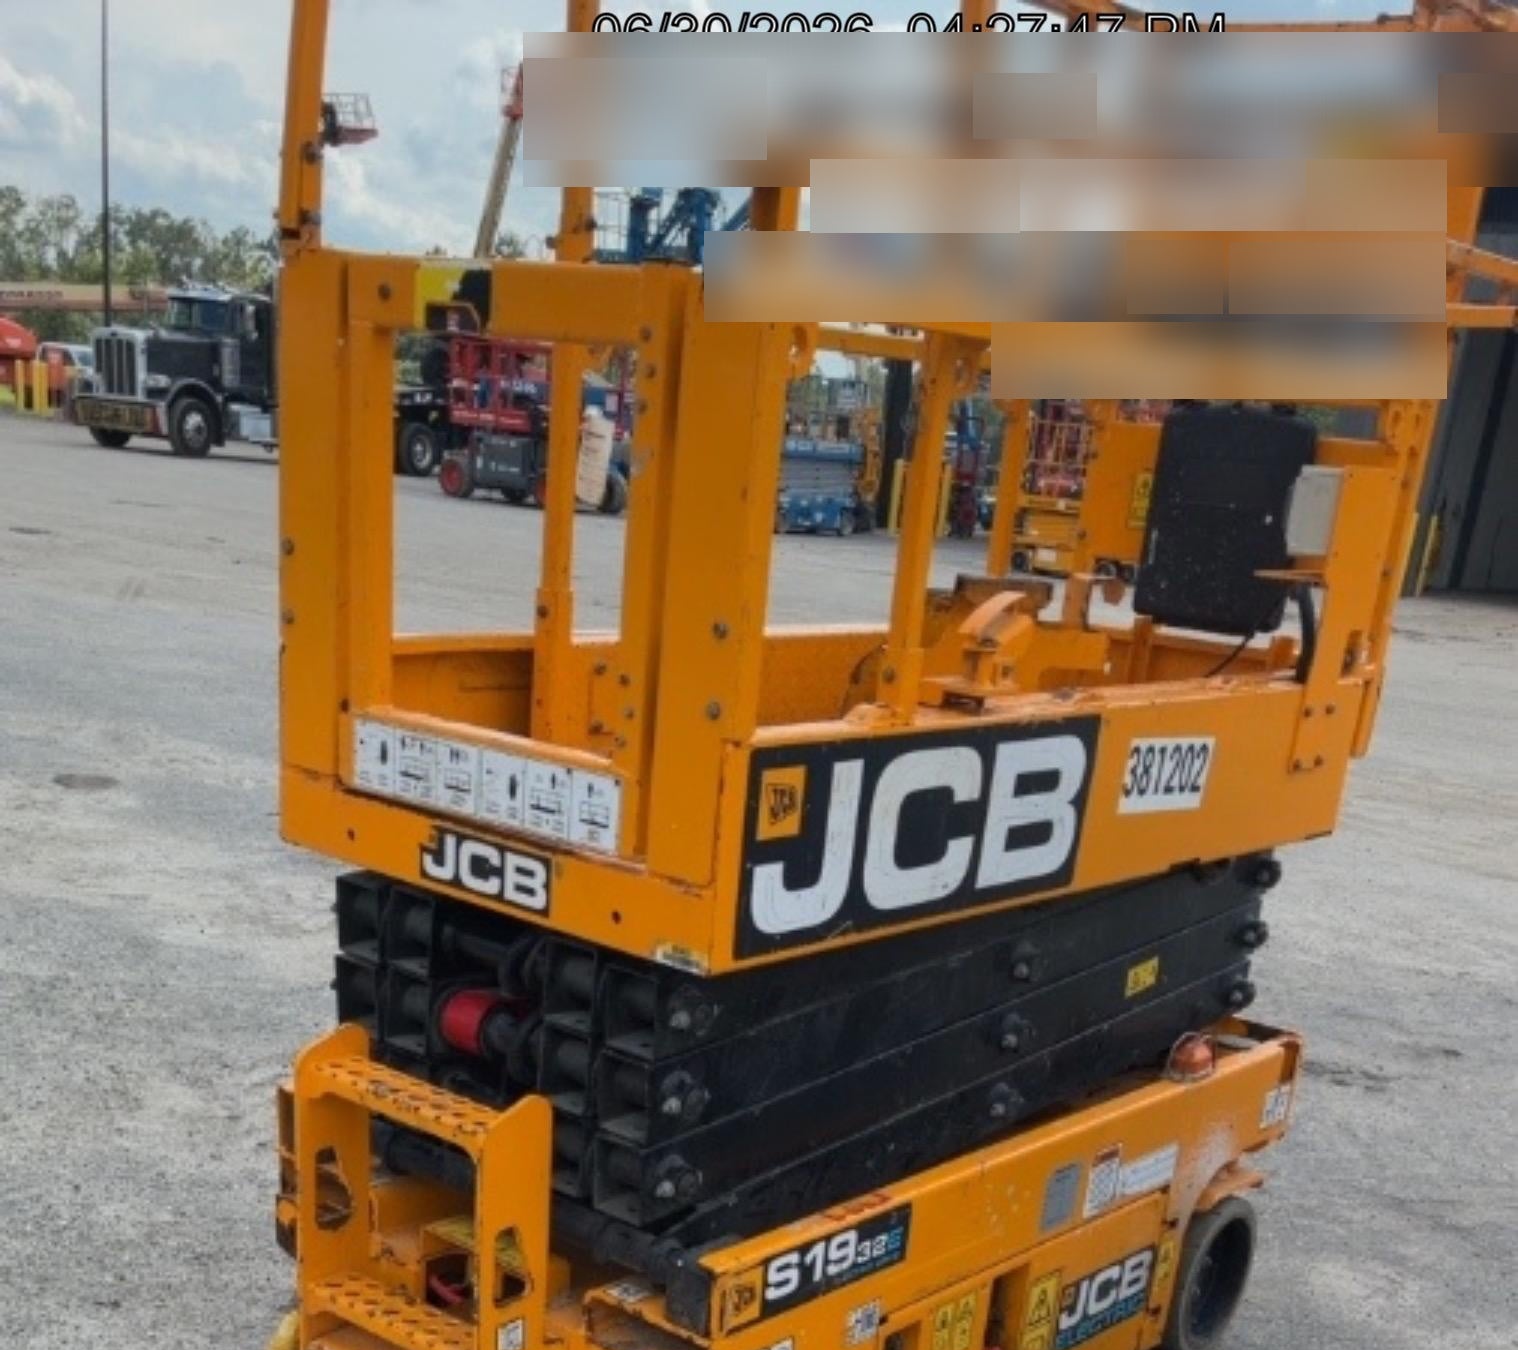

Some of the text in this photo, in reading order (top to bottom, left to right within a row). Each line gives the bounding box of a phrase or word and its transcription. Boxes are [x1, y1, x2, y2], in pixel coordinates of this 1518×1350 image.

[1122, 743, 1209, 799] 381202
[422, 833, 547, 910] JCB
[751, 734, 1088, 935] JCB
[1059, 1249, 1153, 1330] JCB
